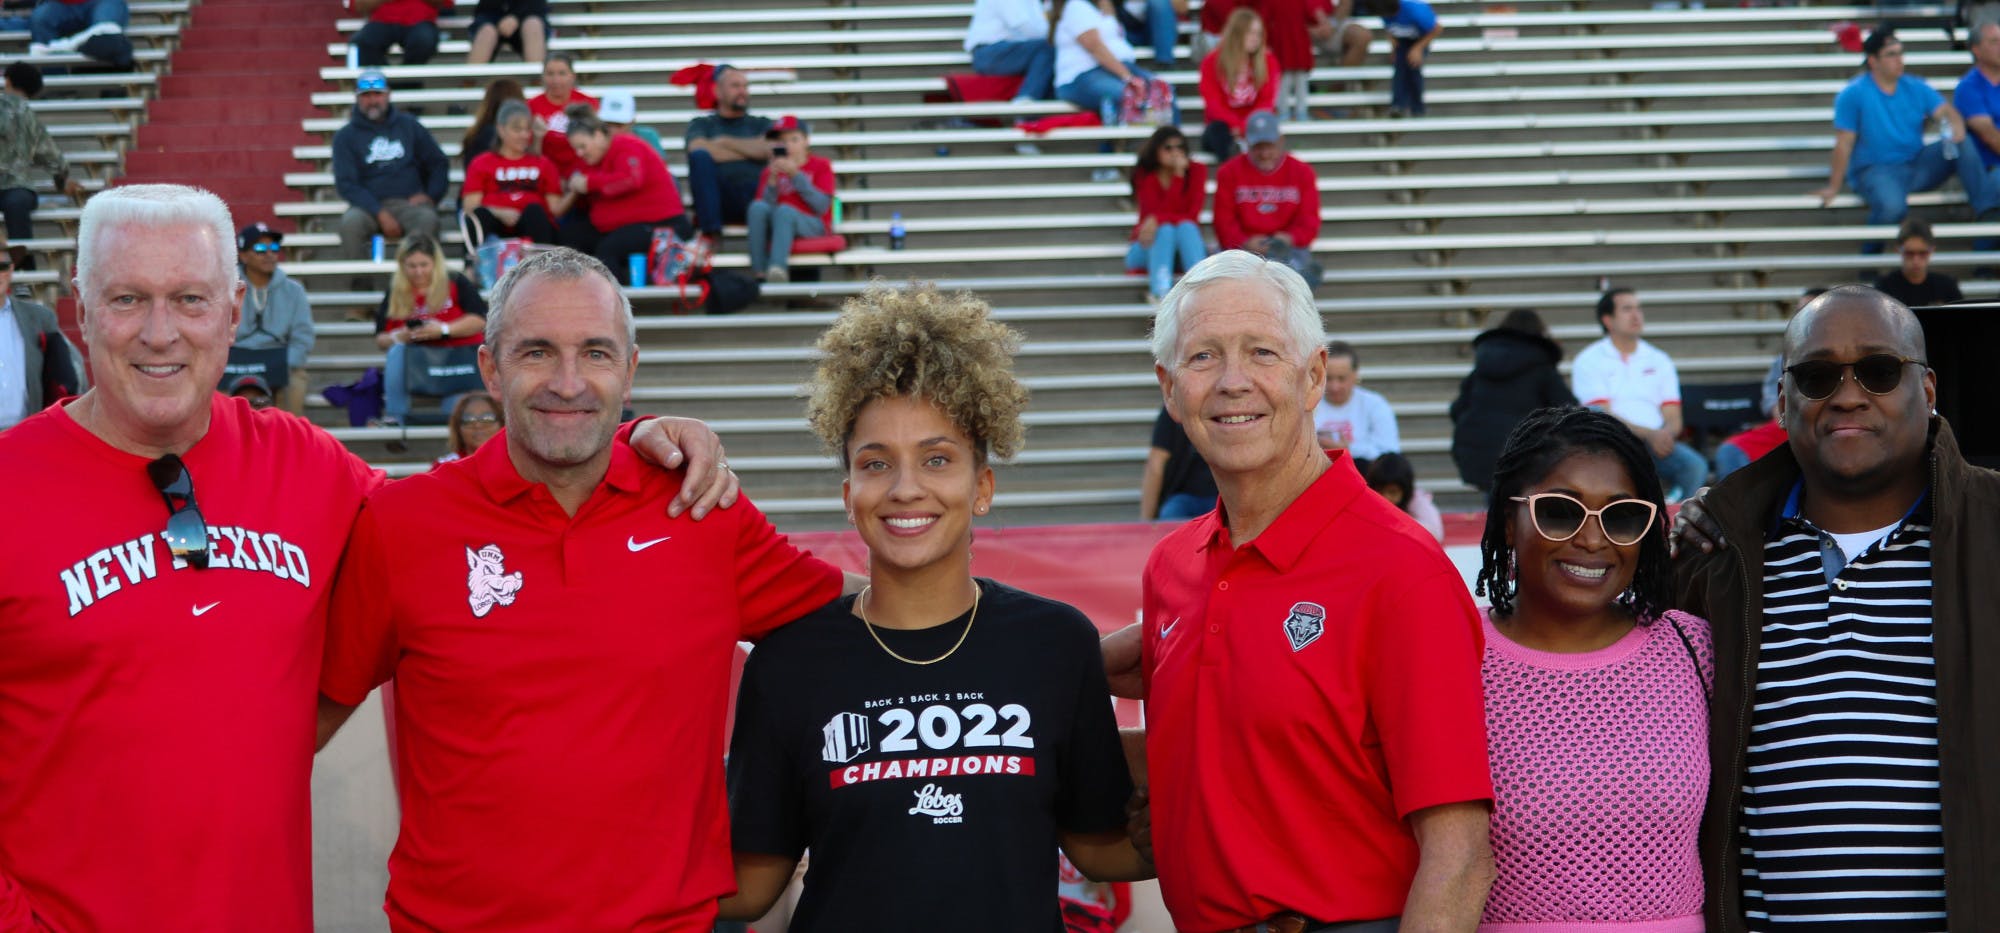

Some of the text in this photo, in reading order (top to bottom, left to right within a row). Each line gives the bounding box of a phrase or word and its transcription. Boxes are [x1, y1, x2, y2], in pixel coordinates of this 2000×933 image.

[481, 551, 500, 561] UNM
[59, 526, 311, 617] NEW EXICO
[865, 699, 892, 708] BACK
[911, 694, 938, 703] BACK
[945, 693, 950, 701] 2
[957, 692, 984, 700] BACK
[878, 703, 1034, 752] 2022
[843, 756, 1022, 784] CHAMPIONS
[909, 783, 964, 816] Lobos
[933, 816, 963, 825] SOCCER
